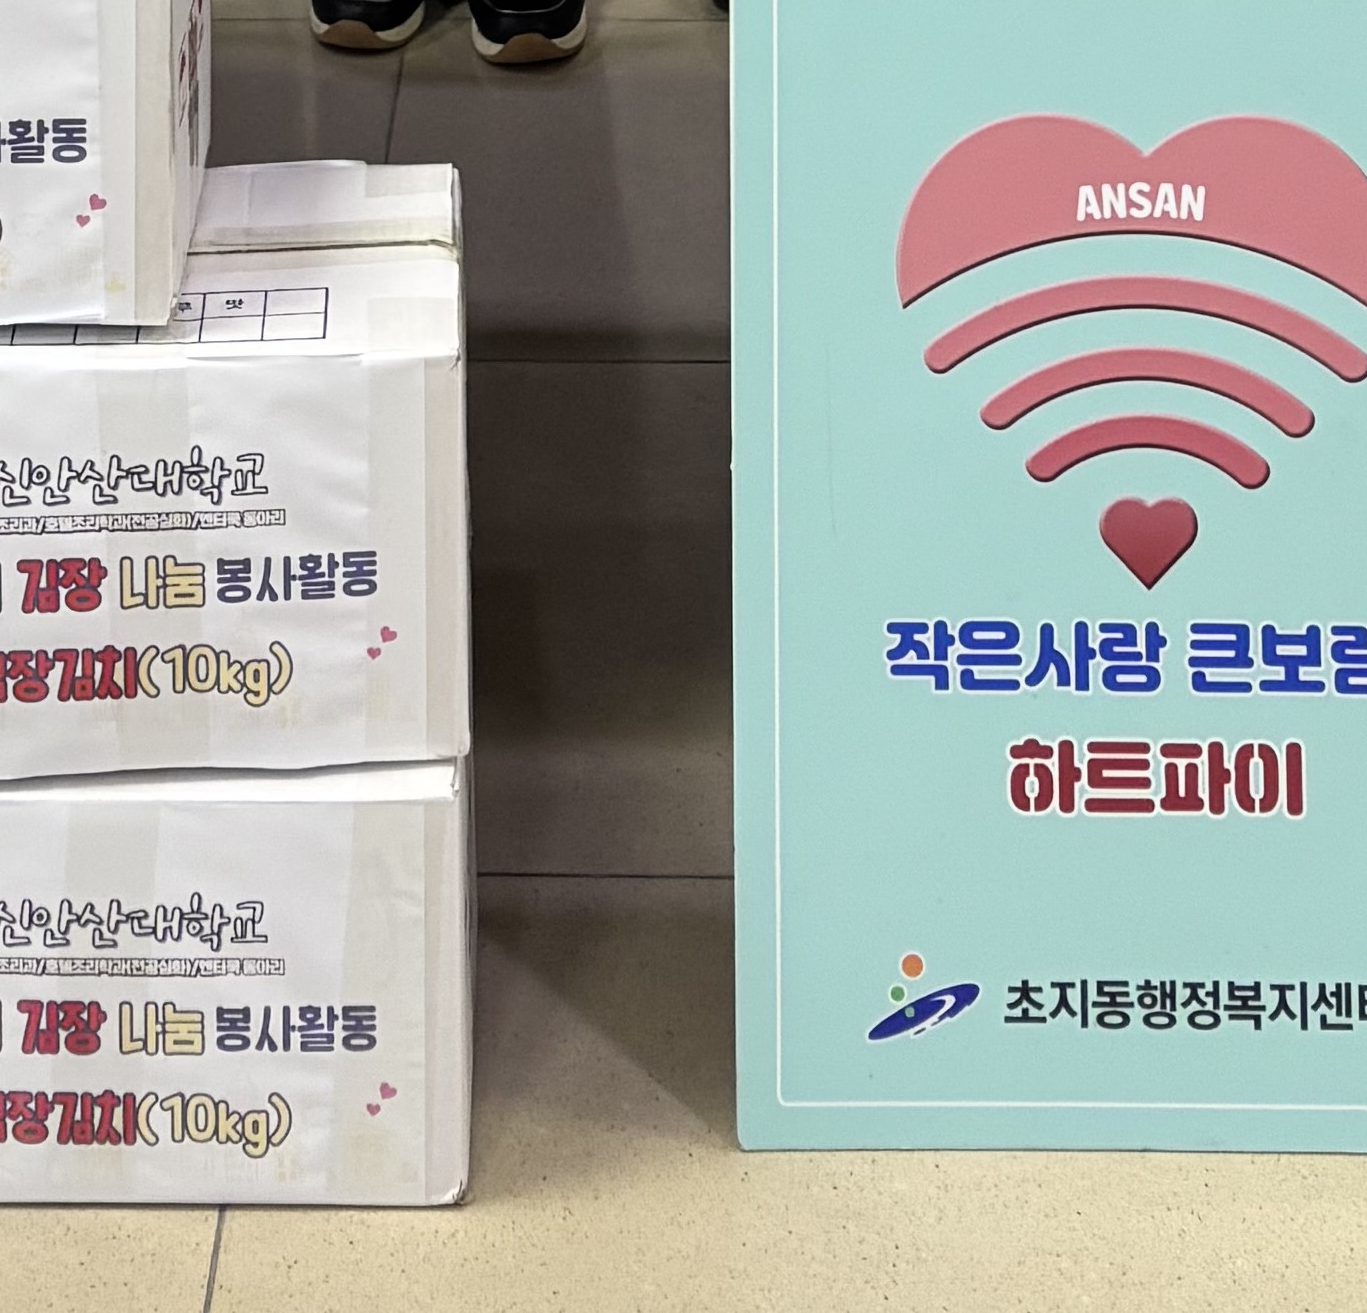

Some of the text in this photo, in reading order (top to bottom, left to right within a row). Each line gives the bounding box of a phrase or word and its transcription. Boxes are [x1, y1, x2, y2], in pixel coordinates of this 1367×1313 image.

[1076, 181, 1206, 222] ANSAN
[884, 619, 1169, 693] 작은사랑
[1008, 737, 1306, 817] 하트파이
